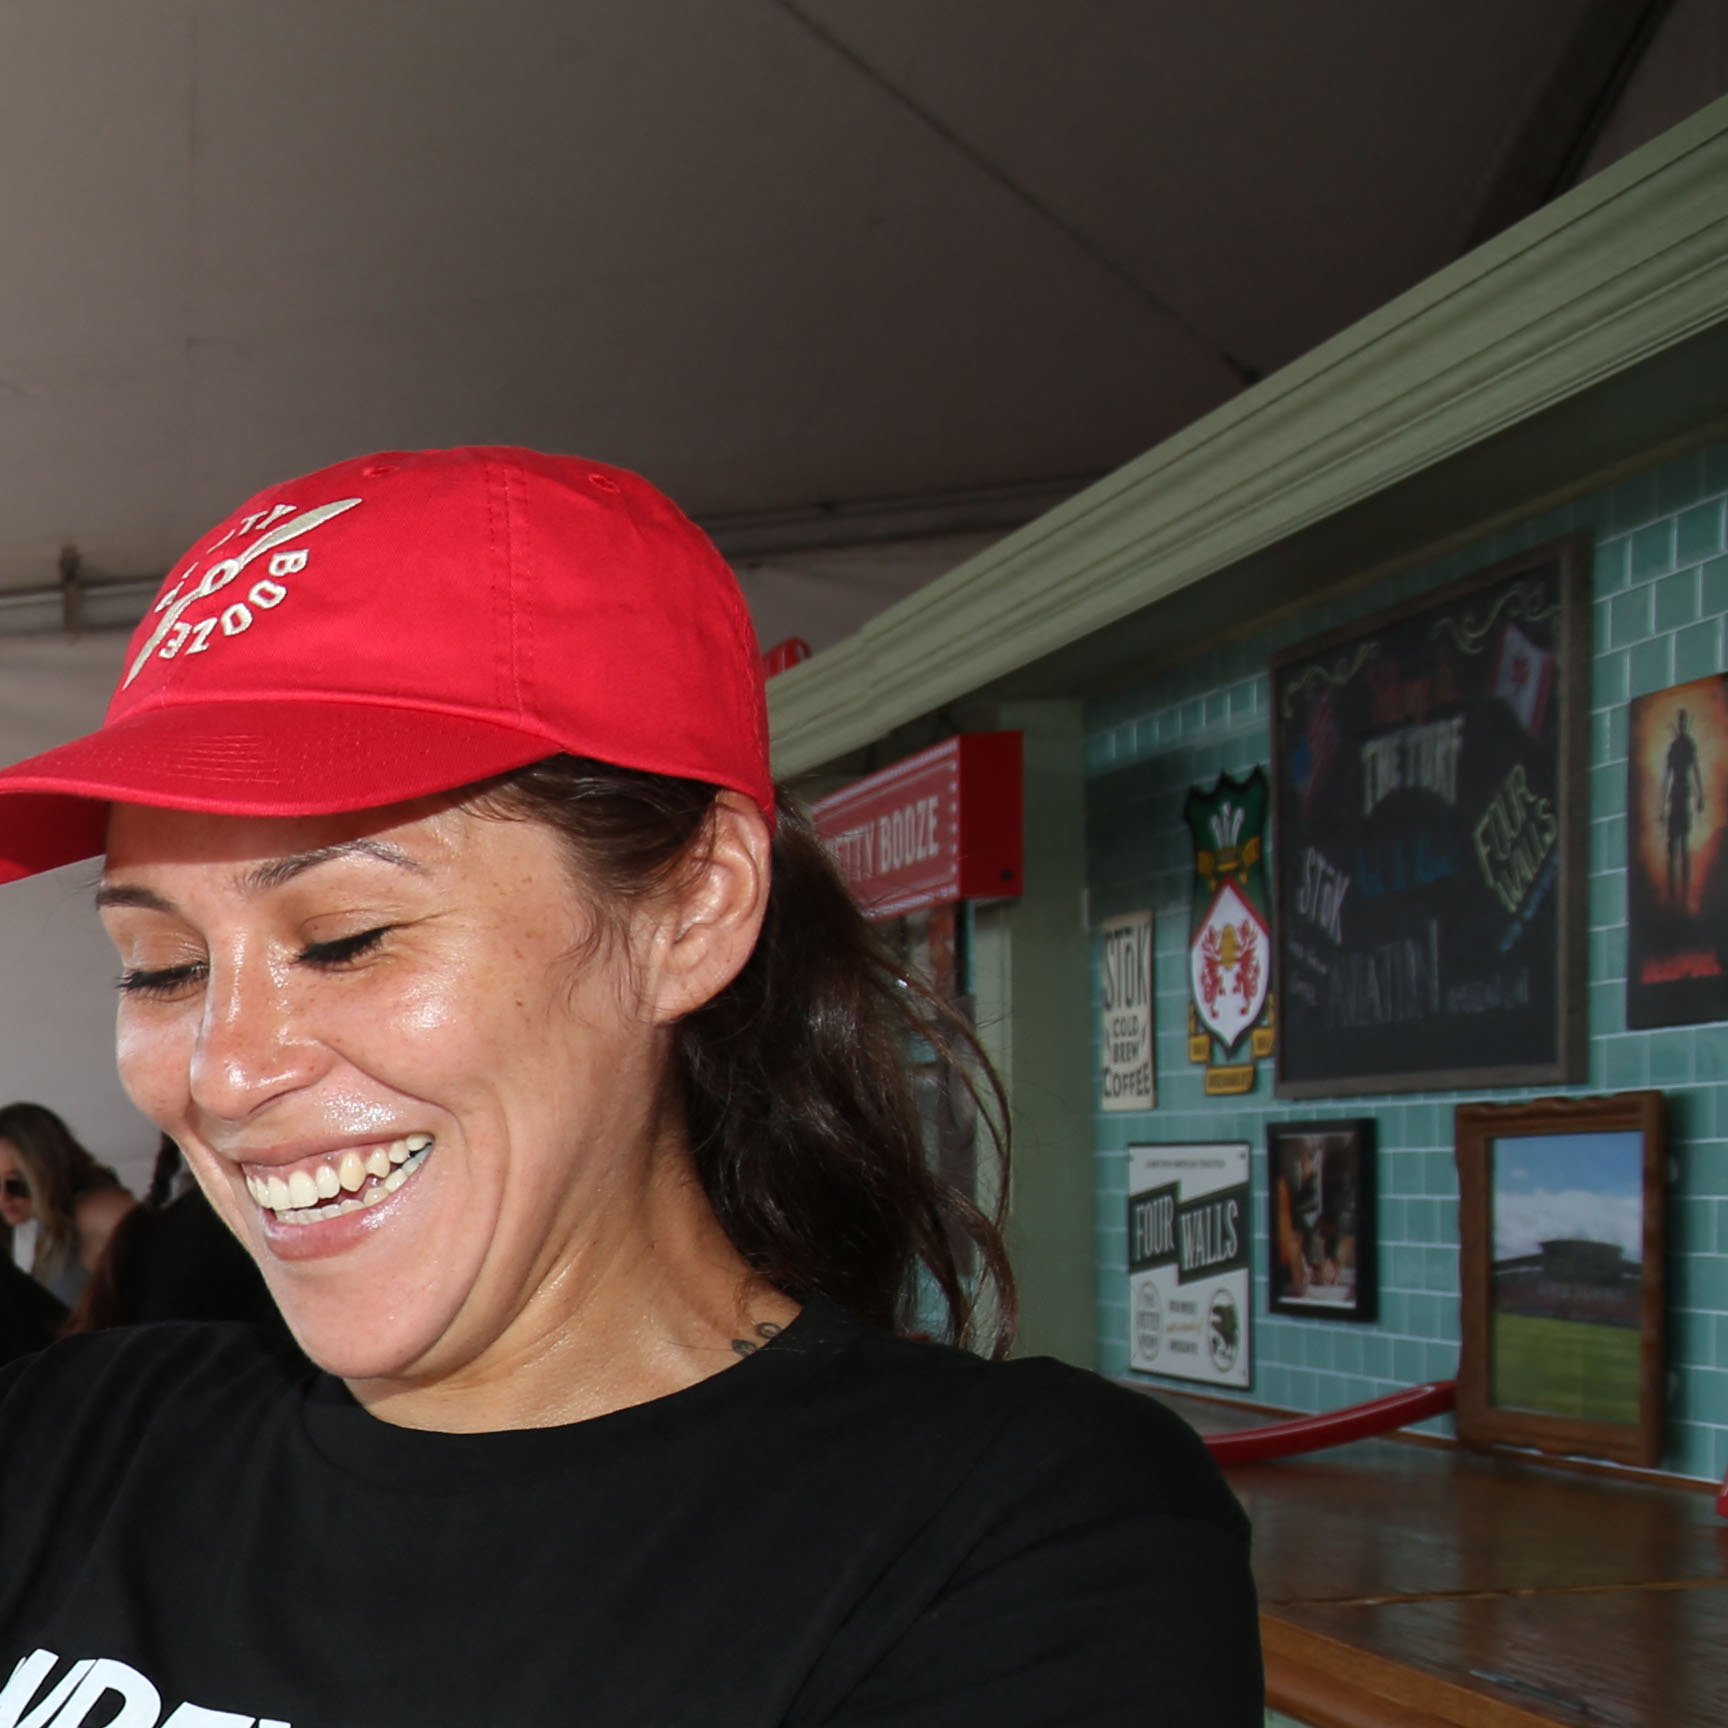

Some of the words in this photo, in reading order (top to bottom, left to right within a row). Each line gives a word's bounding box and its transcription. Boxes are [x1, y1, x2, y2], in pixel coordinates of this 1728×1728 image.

[158, 549, 309, 658] BOOZE
[879, 795, 940, 874] BOOZE
[1103, 1062, 1151, 1098] COFFEE
[1136, 1195, 1174, 1262] FOUR
[1181, 1199, 1238, 1272] WALLS
